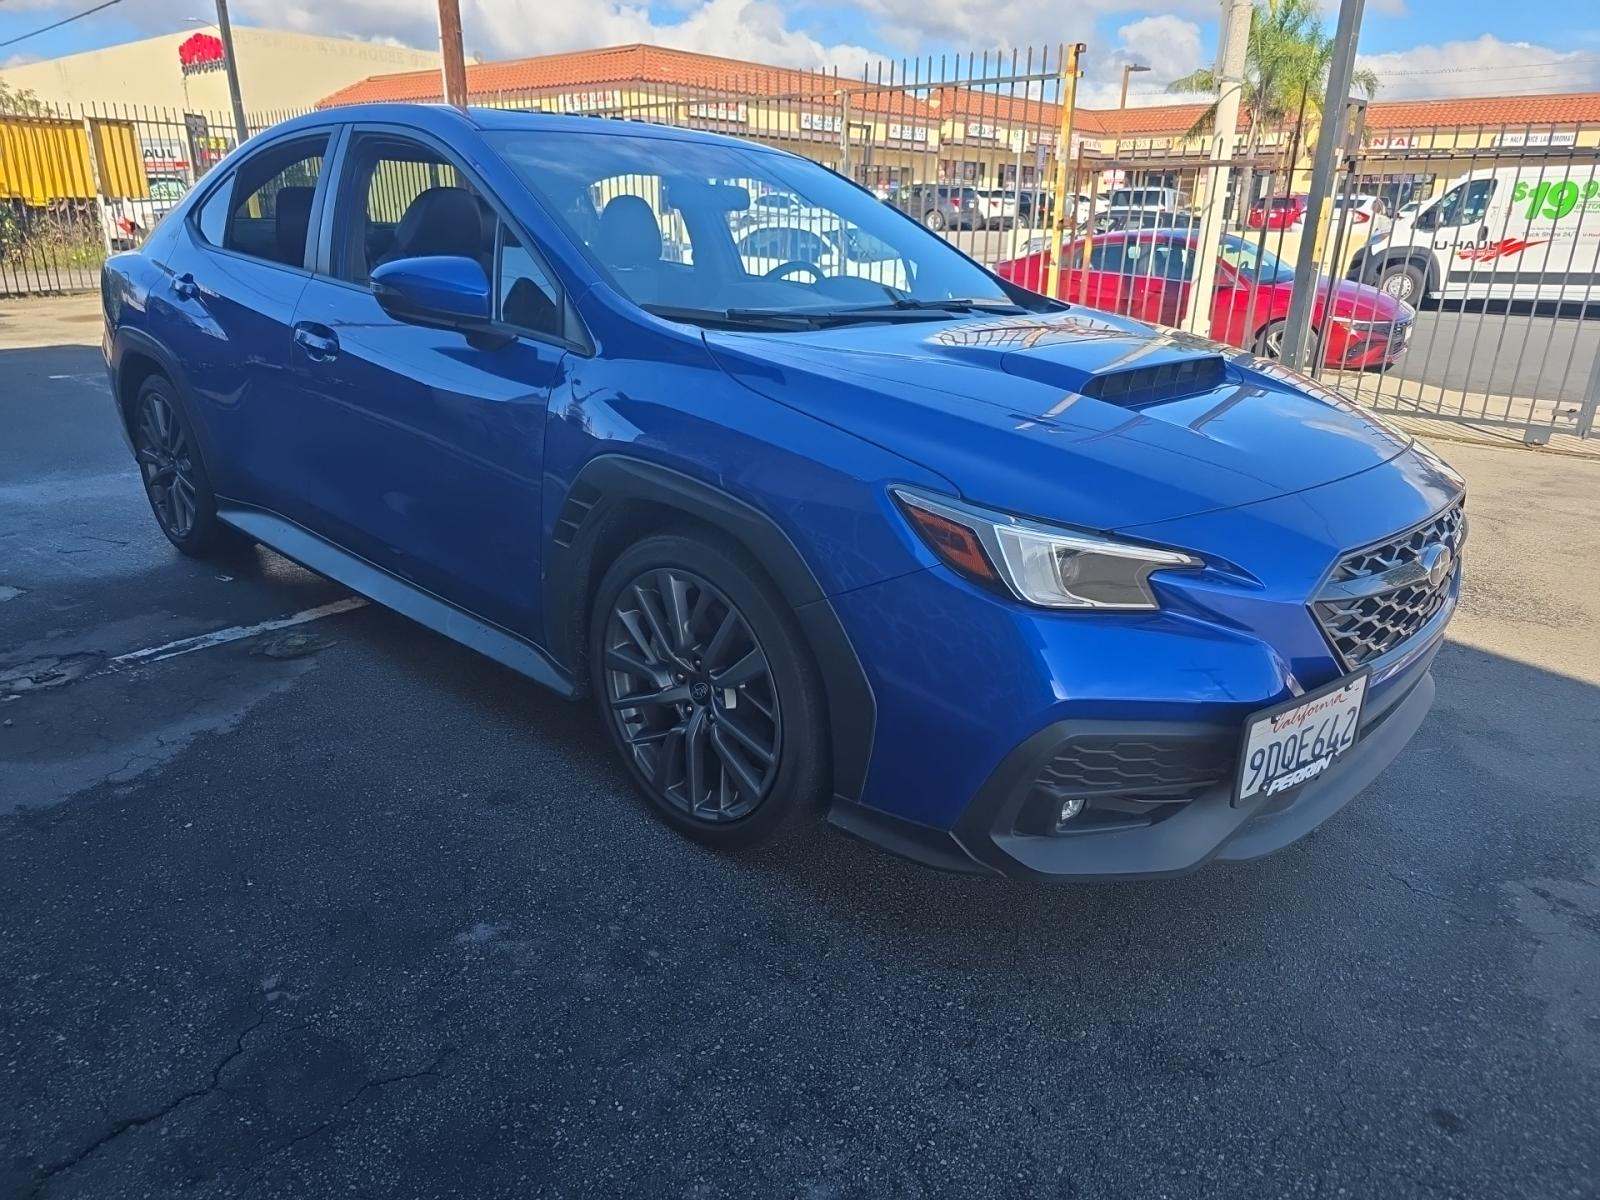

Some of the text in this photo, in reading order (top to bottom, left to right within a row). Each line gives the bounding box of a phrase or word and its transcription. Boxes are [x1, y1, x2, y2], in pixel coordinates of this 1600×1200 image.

[1540, 134, 1574, 142] LAUDROMAT
[144, 149, 177, 158] AUL
[1434, 240, 1497, 250] U-HAUL
[1272, 692, 1347, 733] California
[1246, 706, 1357, 791] 9DQE642
